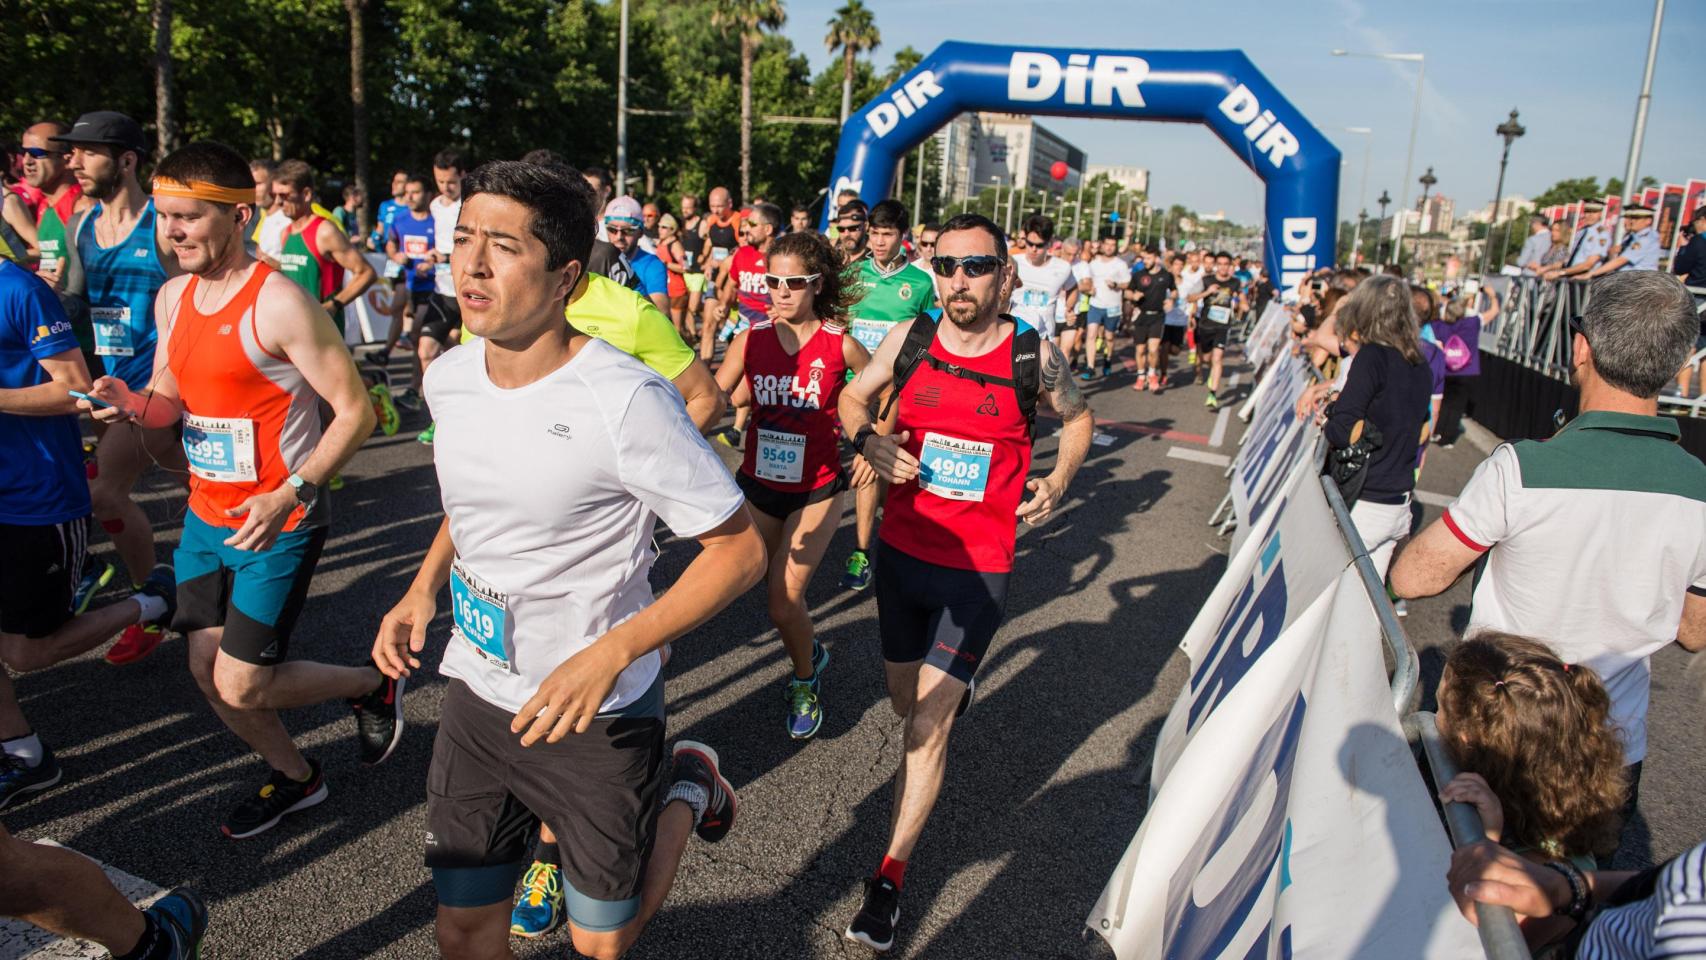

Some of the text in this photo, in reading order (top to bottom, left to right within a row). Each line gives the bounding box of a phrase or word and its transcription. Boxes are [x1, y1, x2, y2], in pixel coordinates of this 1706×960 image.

[1008, 51, 1150, 108] DiR
[865, 70, 944, 139] DiR
[1218, 83, 1300, 169] DiR
[755, 390, 820, 410] MITJA
[186, 436, 225, 459] 2395
[763, 447, 797, 464] 9549
[930, 457, 980, 480] 4908
[938, 474, 971, 486] YOHANN
[456, 592, 495, 639] 1619
